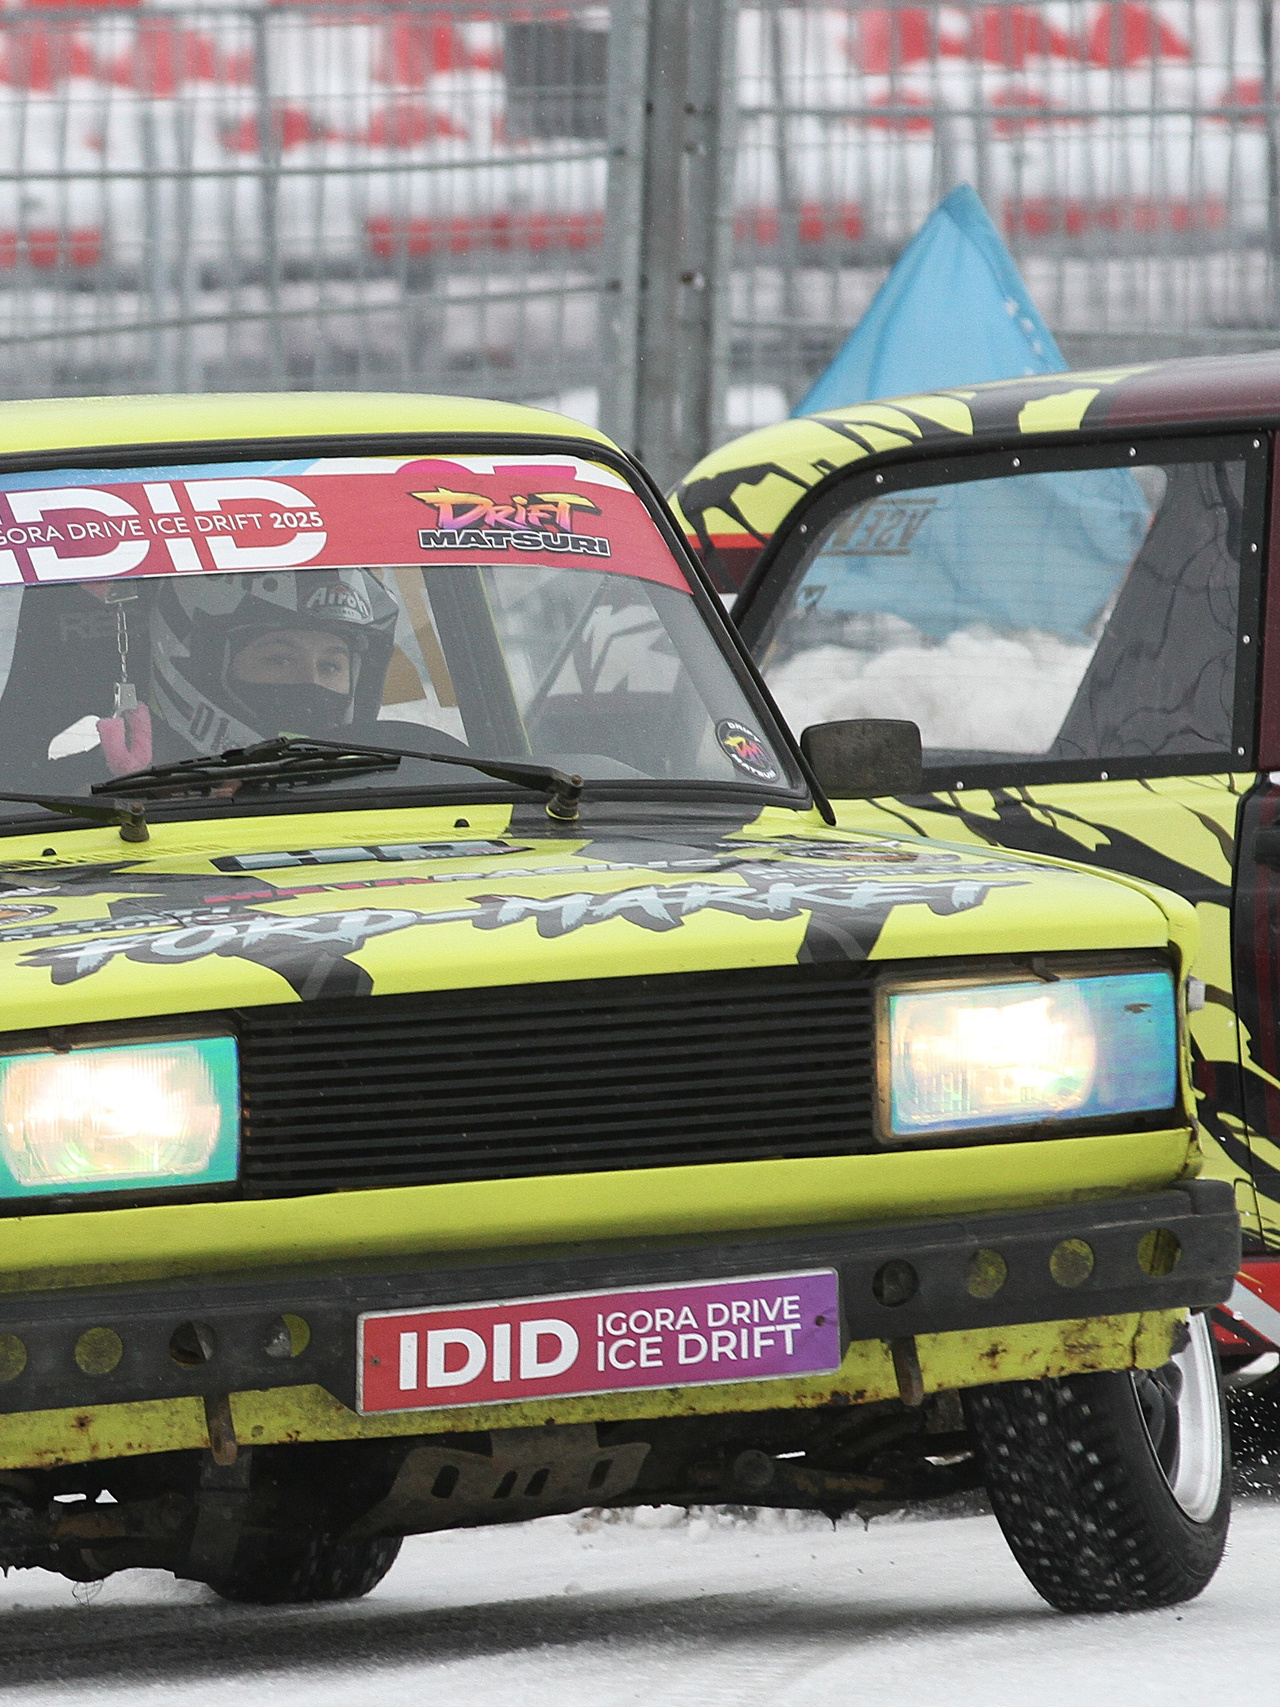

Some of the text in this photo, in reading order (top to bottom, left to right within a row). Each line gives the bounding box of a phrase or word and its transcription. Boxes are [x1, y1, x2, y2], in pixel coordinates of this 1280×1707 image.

[67, 518, 144, 541] DRIVE
[148, 516, 189, 536] ICE
[194, 512, 264, 532] DRIFT
[269, 511, 324, 529] 2025
[418, 529, 612, 557] MATSURI
[597, 1295, 801, 1338] IGORA DRIVE
[398, 1319, 580, 1391] IDID
[597, 1323, 802, 1371] ICE DRIFT
